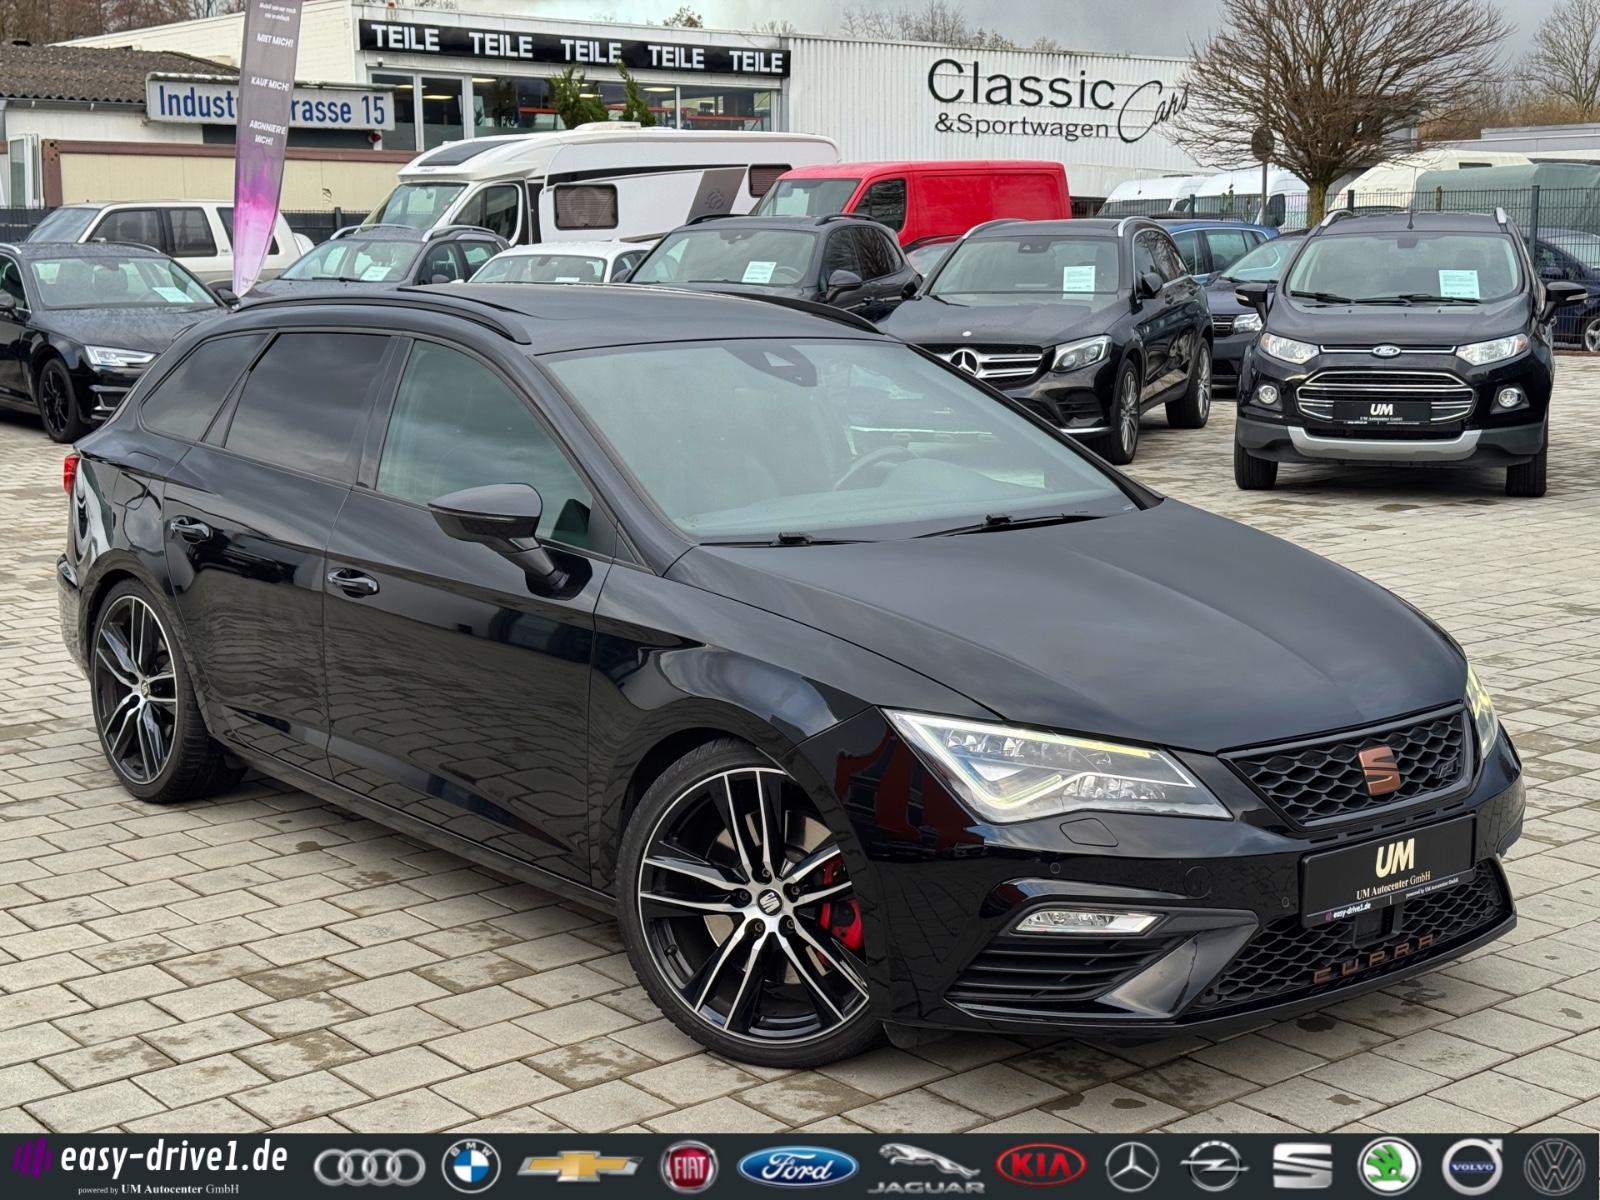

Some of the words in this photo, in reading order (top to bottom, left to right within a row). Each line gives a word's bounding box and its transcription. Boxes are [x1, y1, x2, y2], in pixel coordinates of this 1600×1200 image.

[256, 33, 272, 44] MIET
[272, 36, 294, 48] MICH!
[371, 24, 440, 51] TEILE
[469, 32, 533, 58] TEILE
[560, 39, 623, 63] TEILE
[647, 45, 705, 69] TEILE
[729, 50, 783, 73] TEILE
[250, 76, 268, 87] KAUF
[268, 80, 290, 92] MICH!
[362, 95, 385, 125] 15
[928, 58, 1116, 110] Classic
[1117, 80, 1190, 143] Cars
[249, 120, 287, 135] ABONNIERE
[254, 134, 274, 146] MICH!
[934, 112, 1109, 142] &Sportwagen
[1370, 403, 1394, 416] UM
[1375, 838, 1415, 878] UM
[1356, 889, 1371, 900] UM
[1372, 879, 1409, 897] Autocenter
[1410, 871, 1432, 886] GmbH
[1313, 934, 1434, 984] CUPRA
